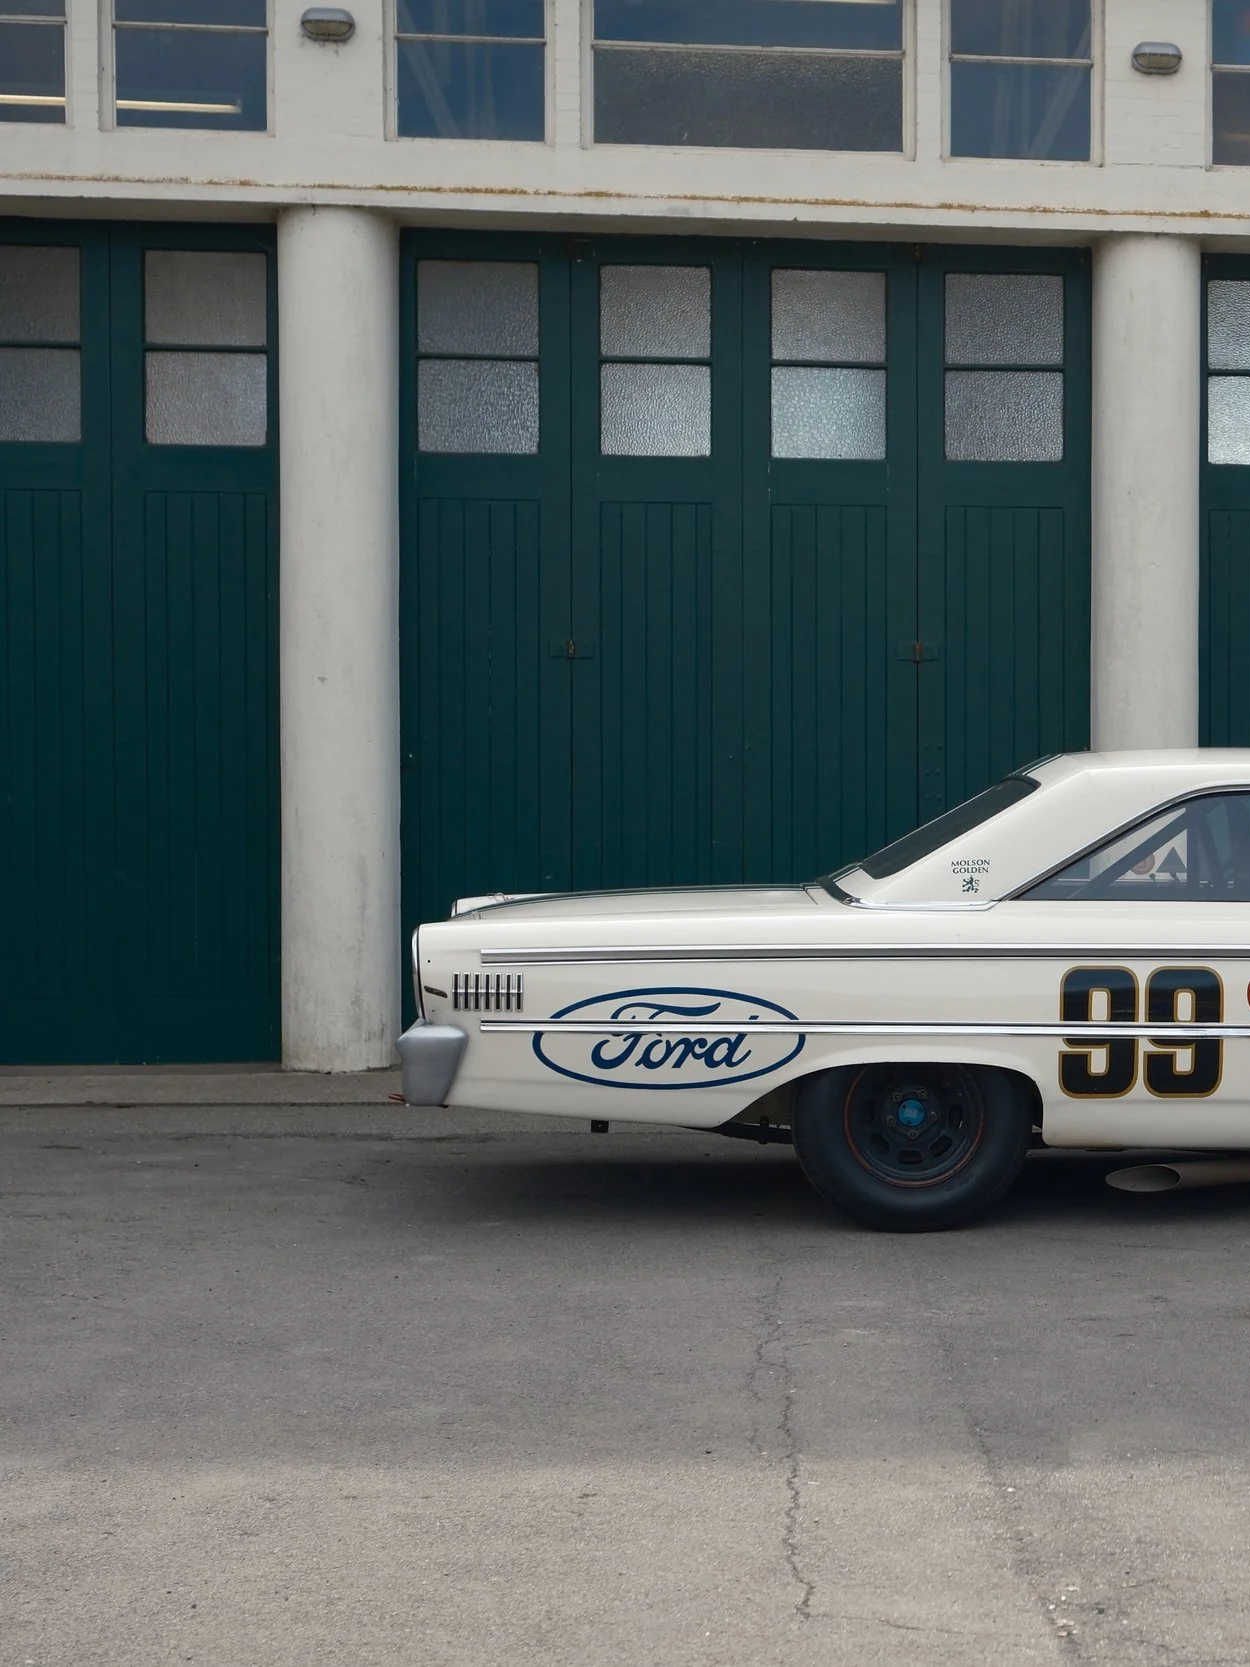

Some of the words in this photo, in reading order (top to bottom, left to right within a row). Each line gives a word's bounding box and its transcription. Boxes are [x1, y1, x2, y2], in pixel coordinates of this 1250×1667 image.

[950, 859, 991, 867] MOLSON
[952, 867, 989, 875] GOLDEN
[591, 1002, 760, 1070] Ford
[1058, 965, 1225, 1099] 99
